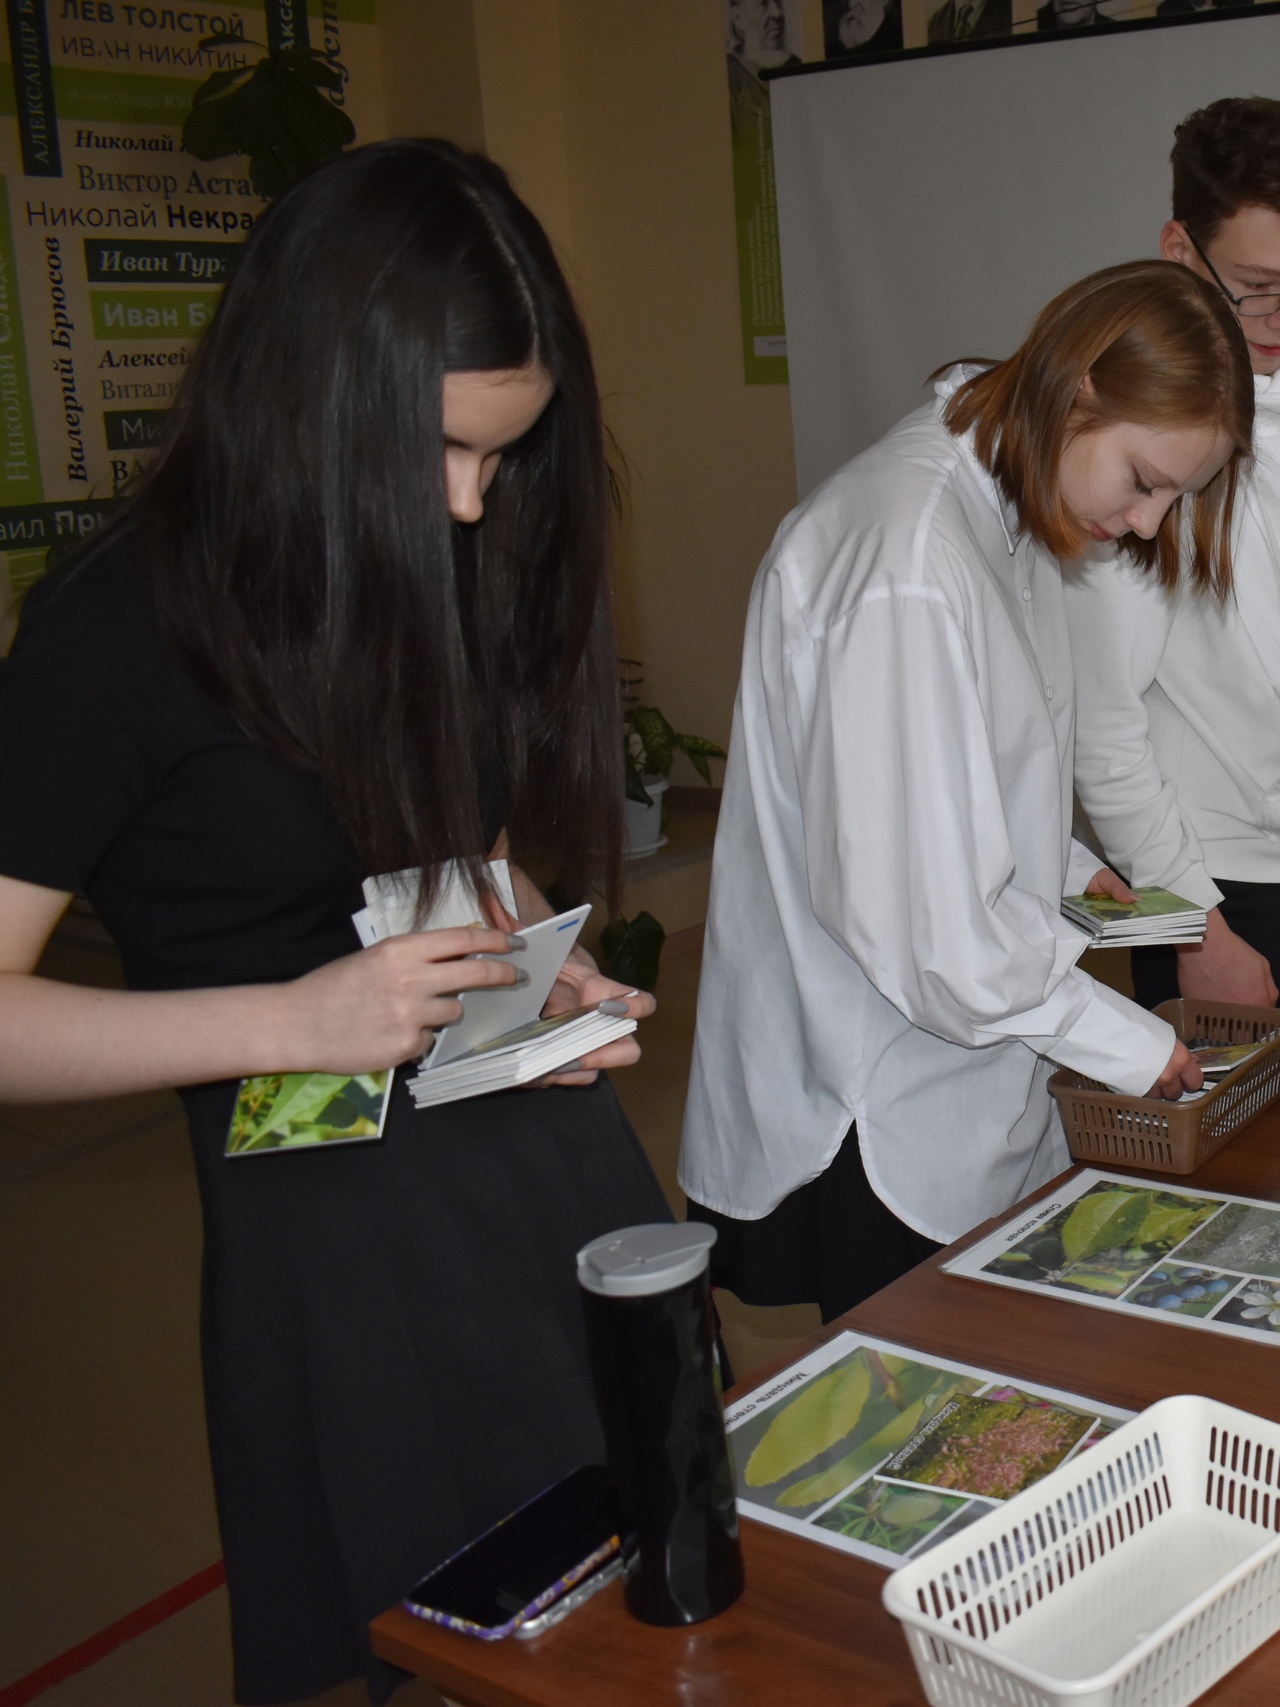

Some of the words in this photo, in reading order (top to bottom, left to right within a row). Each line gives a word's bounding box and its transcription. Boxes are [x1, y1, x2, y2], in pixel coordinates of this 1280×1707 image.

[61, 0, 114, 24] ЛЕВ
[121, 5, 245, 38] ТОЛСТОЙ
[139, 44, 248, 70] НИКИТИН
[20, 20, 50, 165] АЛЕКСАНДР
[75, 129, 174, 152] Николай
[77, 165, 178, 199] Виктор
[185, 169, 270, 202] Аста
[26, 201, 157, 228] Николай
[99, 250, 170, 272] Иван
[45, 236, 76, 349] Брюсов
[103, 303, 179, 328] Иван
[53, 357, 89, 483] Валерий
[755, 1372, 808, 1404] Миндаль
[724, 1404, 757, 1427] степн
